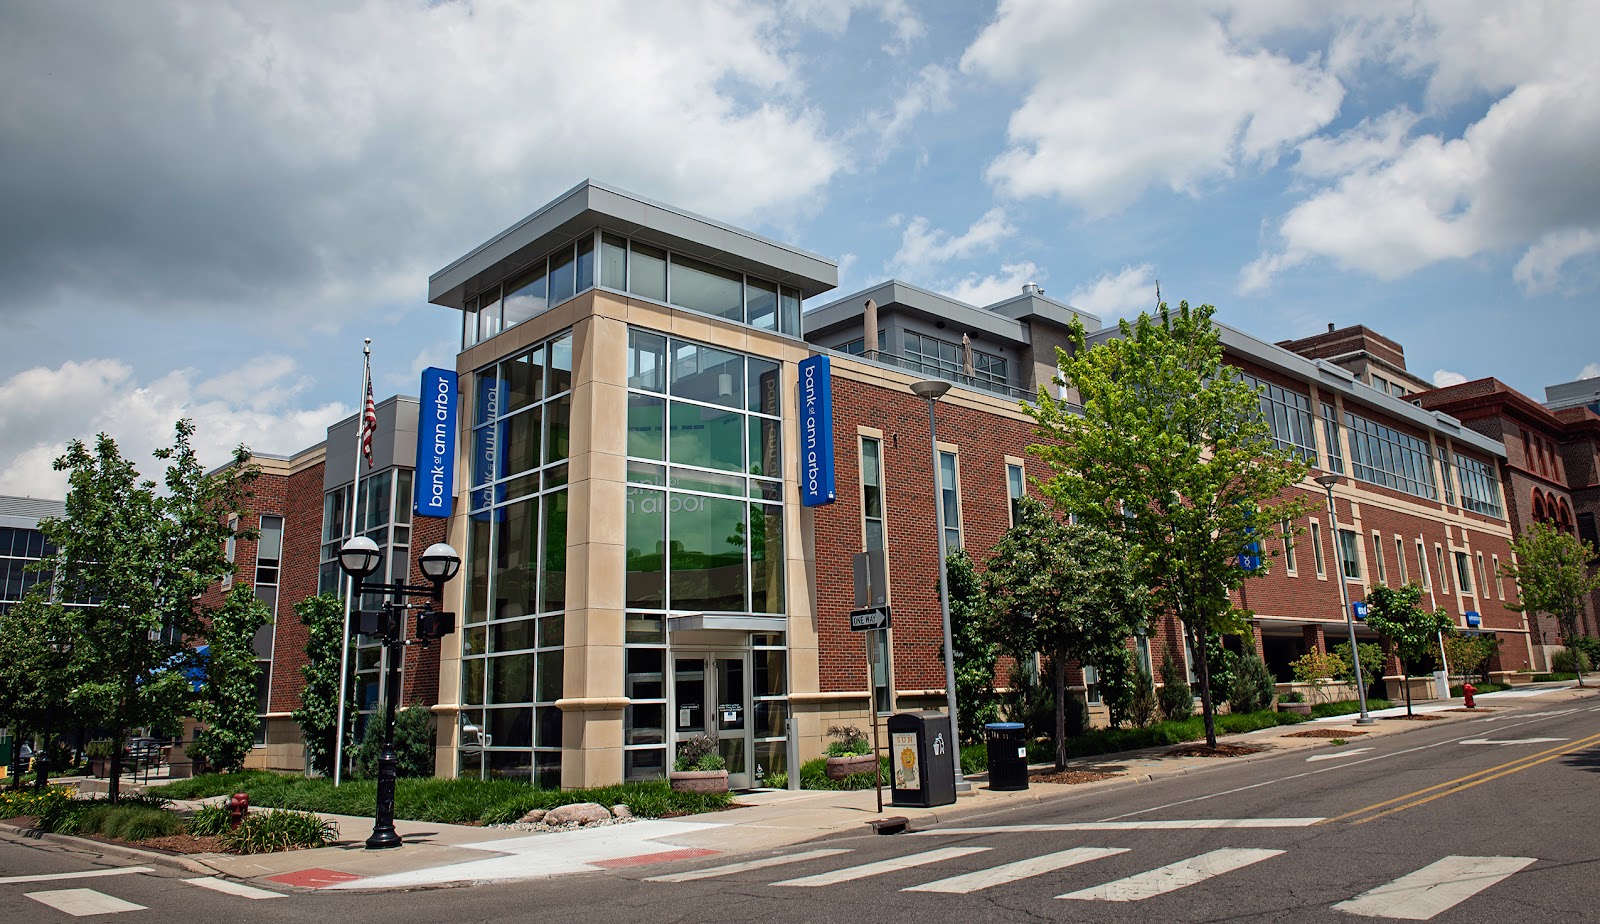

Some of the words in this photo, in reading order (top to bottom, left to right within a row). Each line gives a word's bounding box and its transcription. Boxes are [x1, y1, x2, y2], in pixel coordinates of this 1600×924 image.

[434, 376, 450, 421] arbor
[804, 365, 817, 407] bank
[808, 406, 815, 415] of
[434, 423, 447, 455] ann
[806, 417, 817, 449] ann
[434, 455, 442, 465] of
[807, 451, 820, 496] arbor
[428, 465, 445, 508] bank
[853, 615, 865, 625] ONE
[865, 614, 877, 624] WAY
[896, 736, 913, 744] SUN
